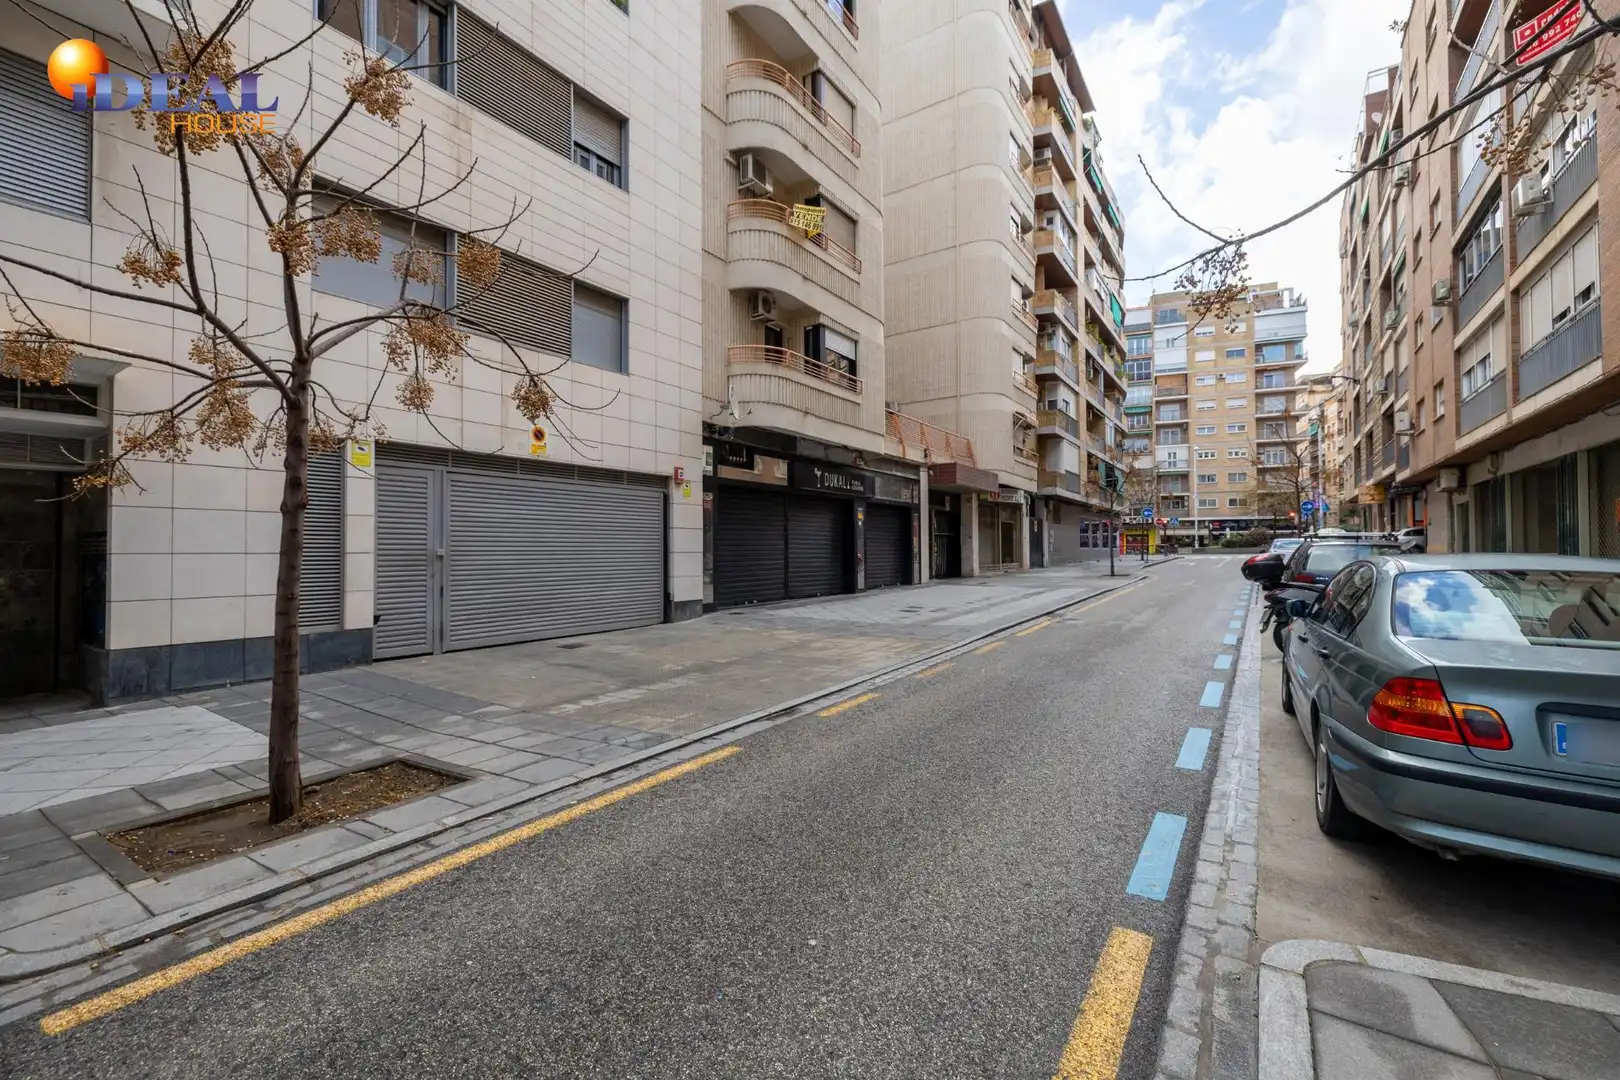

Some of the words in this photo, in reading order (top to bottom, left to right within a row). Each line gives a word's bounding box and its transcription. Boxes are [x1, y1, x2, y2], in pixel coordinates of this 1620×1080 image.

[1542, 25, 1561, 41] 992
[793, 211, 824, 223] VENDE
[824, 472, 846, 489] DUKAL
